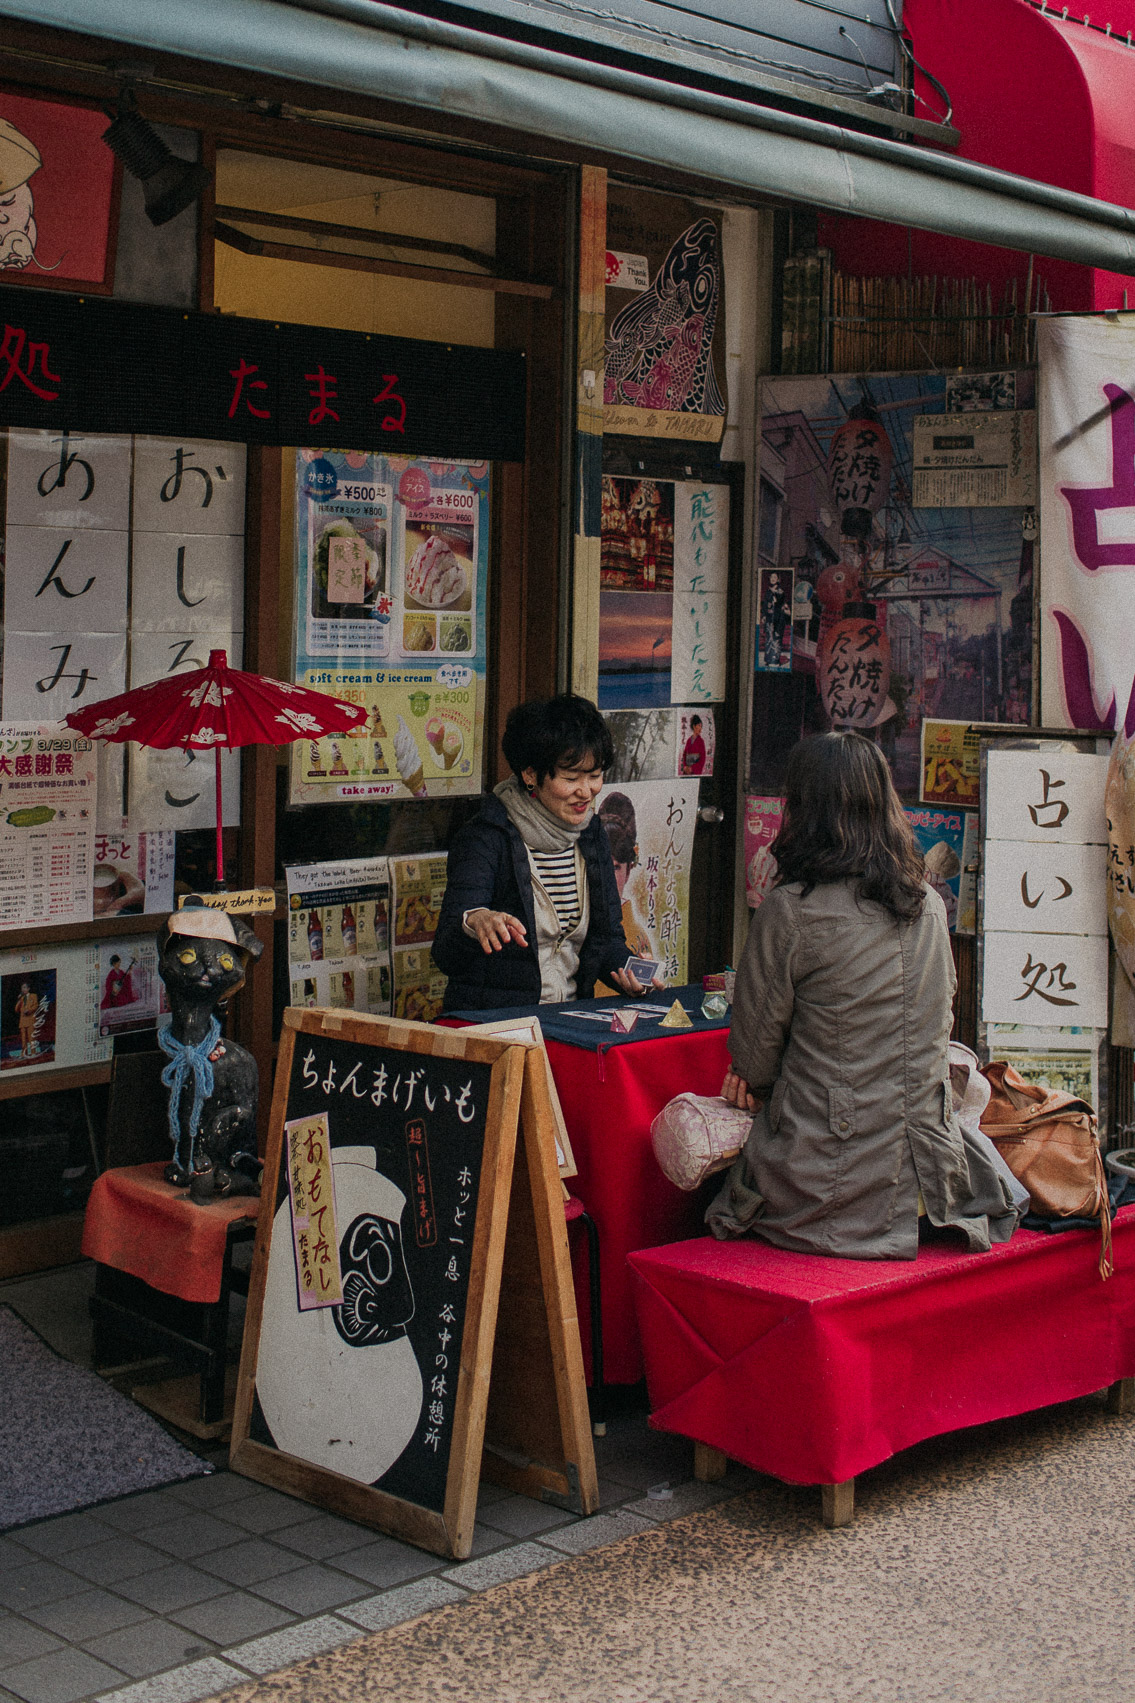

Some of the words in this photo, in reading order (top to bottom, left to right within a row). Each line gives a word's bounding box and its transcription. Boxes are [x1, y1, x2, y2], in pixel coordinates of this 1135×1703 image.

[627, 267, 647, 277] Thank
[634, 278, 647, 286] You.
[0, 323, 62, 402] 処
[228, 358, 407, 435] たまる
[308, 472, 334, 484] かき氷
[344, 485, 376, 501] ¥500
[405, 484, 425, 493] アイス
[848, 429, 881, 505] 夕焼け
[363, 506, 383, 517] ¥800
[408, 510, 423, 519] ミルク
[430, 512, 455, 520] ラズベリー
[456, 513, 472, 522] ¥600
[36, 430, 98, 699] あんみ
[309, 673, 332, 683] soft
[336, 674, 373, 683] cream
[375, 673, 385, 683] &
[388, 673, 403, 683] ice
[405, 675, 433, 683] cream
[848, 623, 883, 720] 夕焼け
[0, 753, 75, 778] 大感謝祭
[37, 739, 93, 752] 3/29(金)
[341, 785, 365, 795] take
[367, 784, 394, 795] away!
[294, 871, 308, 882] They
[311, 872, 319, 880] got
[646, 855, 660, 929] 坂本りえ
[660, 796, 687, 988] おんなの酔い語
[1012, 768, 1080, 1008] 占い処
[302, 1048, 476, 1124] ちょんまげいも
[303, 1126, 331, 1291] おもてなし
[443, 1166, 473, 1282] ホッと一息
[298, 1233, 313, 1288] たまる
[424, 1303, 457, 1453] 谷中の休憩所
